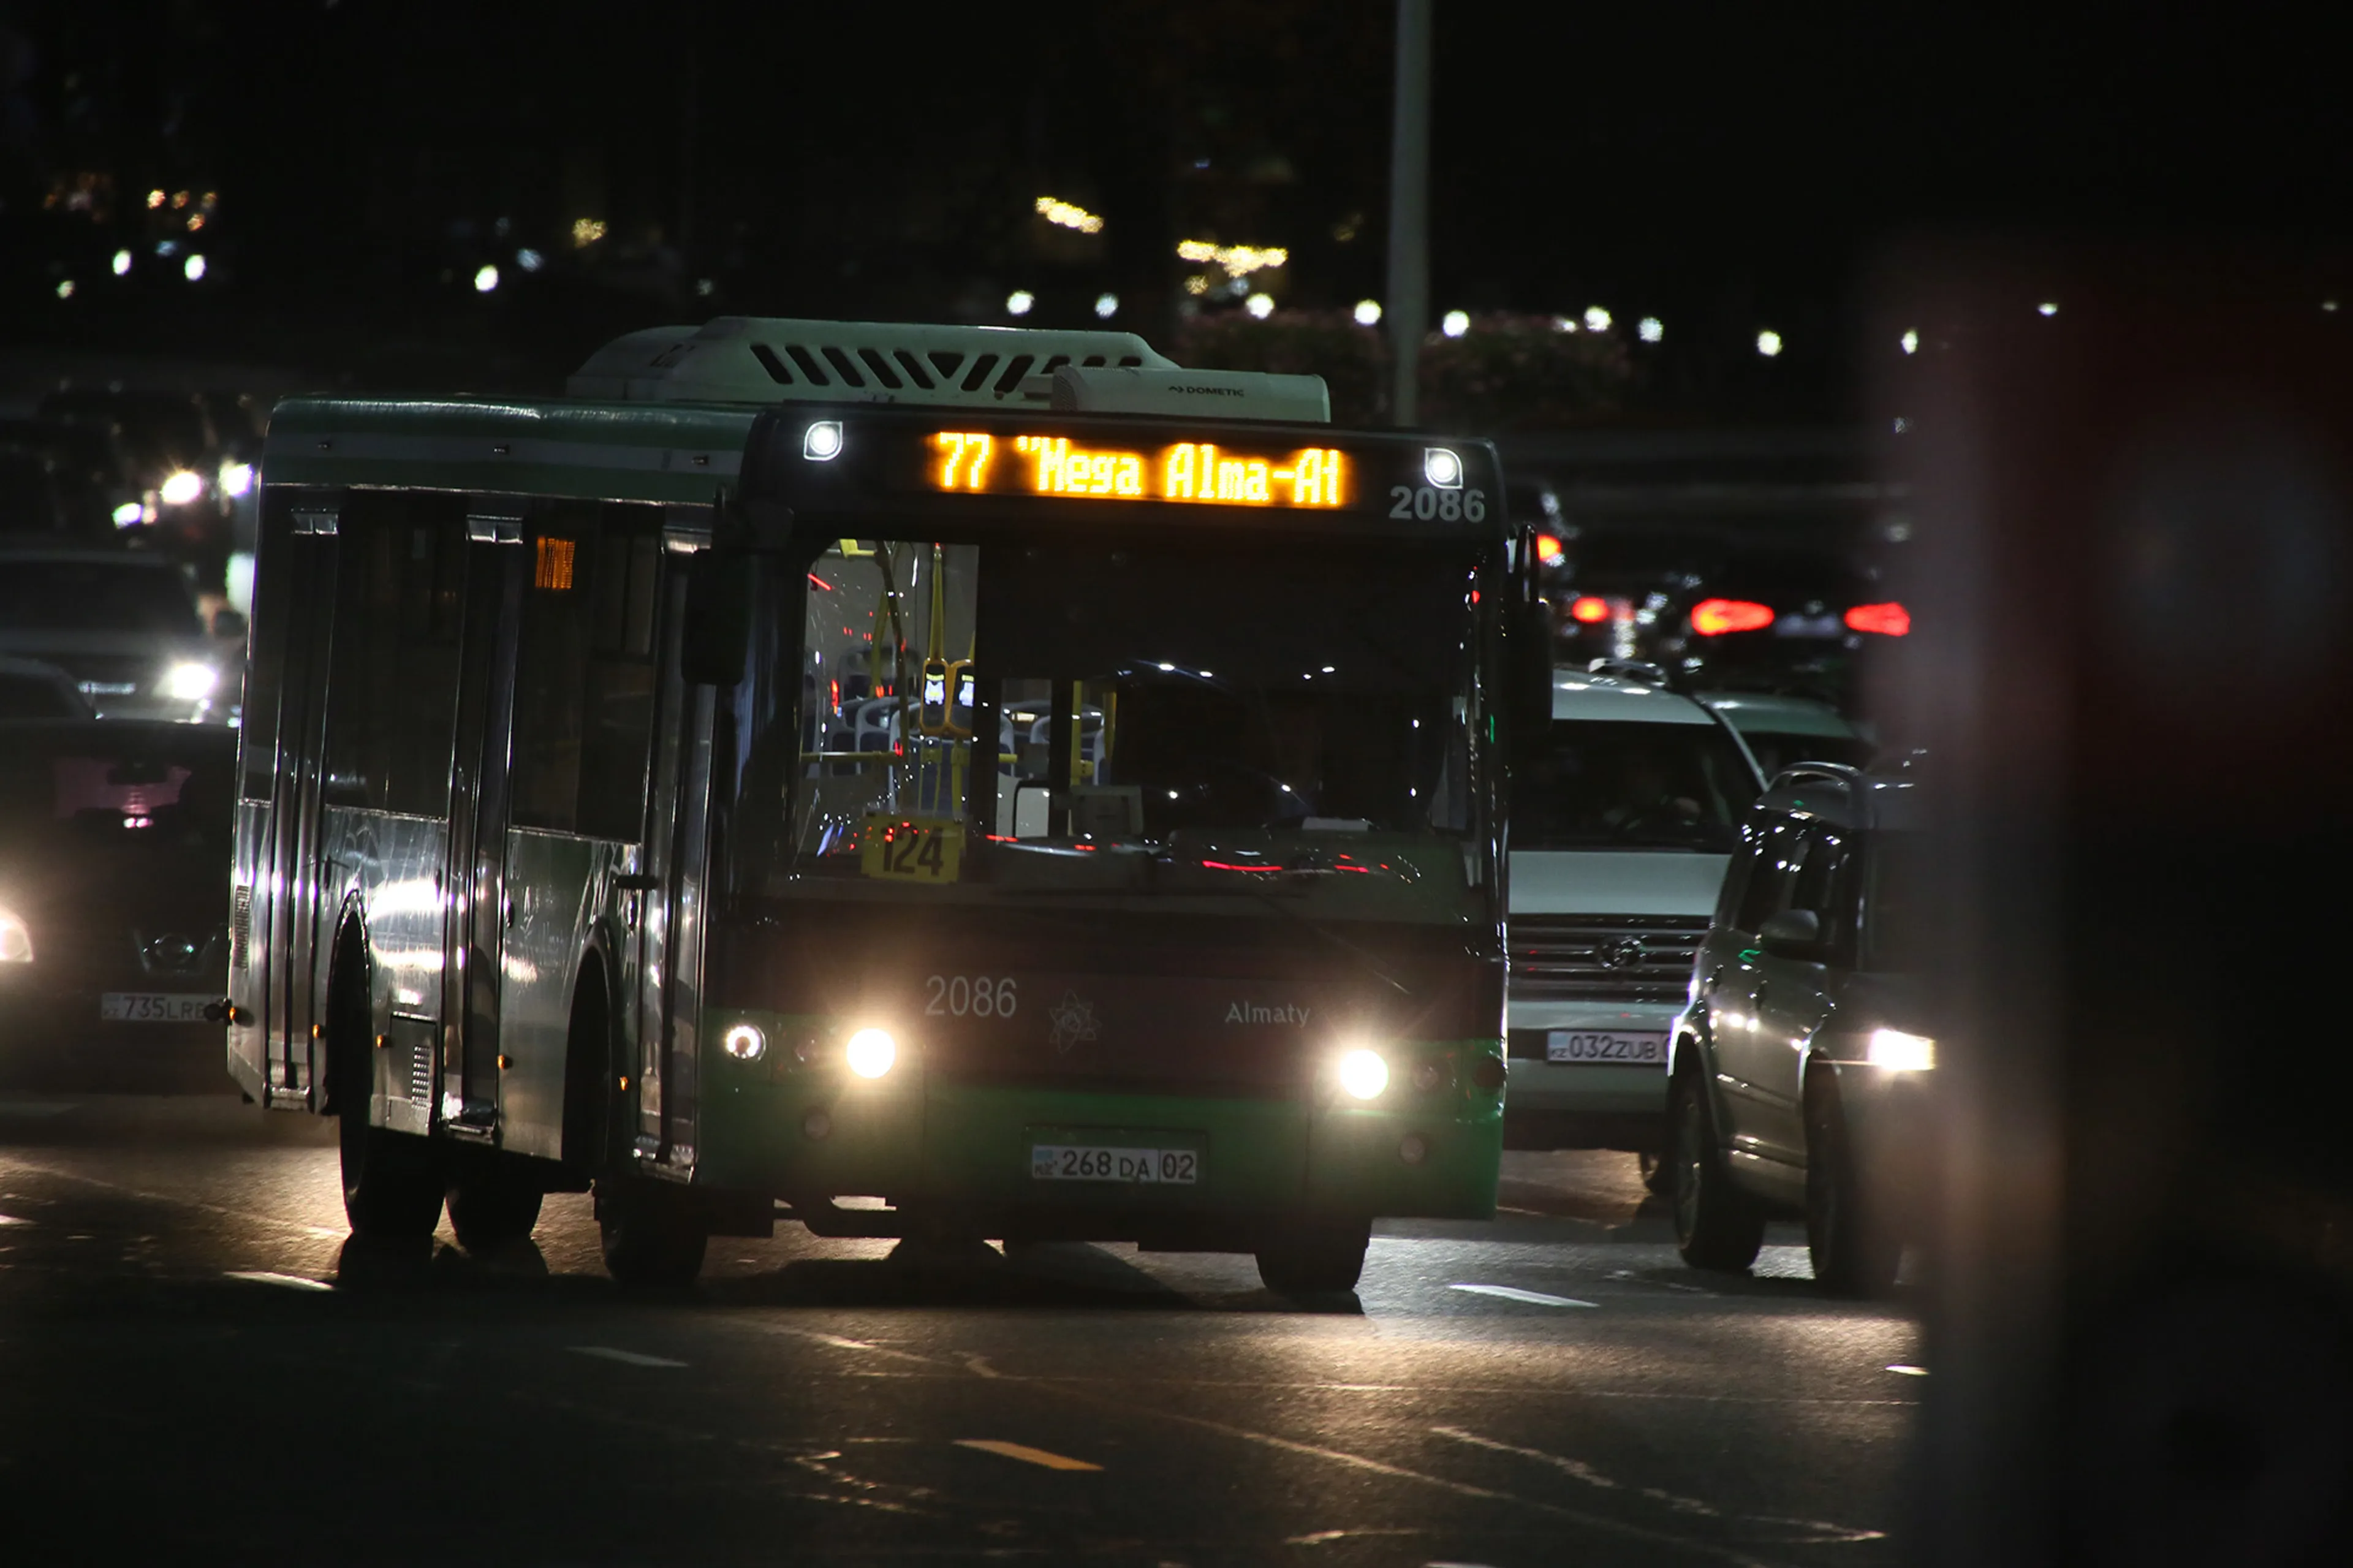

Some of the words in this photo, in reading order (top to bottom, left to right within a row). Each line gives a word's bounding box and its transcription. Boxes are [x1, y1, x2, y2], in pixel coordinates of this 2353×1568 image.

[1186, 385, 1245, 397] DOMETIC
[939, 431, 990, 488] 77
[1389, 485, 1485, 523] 2086
[880, 822, 944, 877] 124
[925, 975, 1017, 1018] 2086
[1225, 1000, 1311, 1029] Almaty
[1061, 1149, 1112, 1176] 268
[1119, 1156, 1150, 1178] DA
[1162, 1153, 1194, 1180] 02
